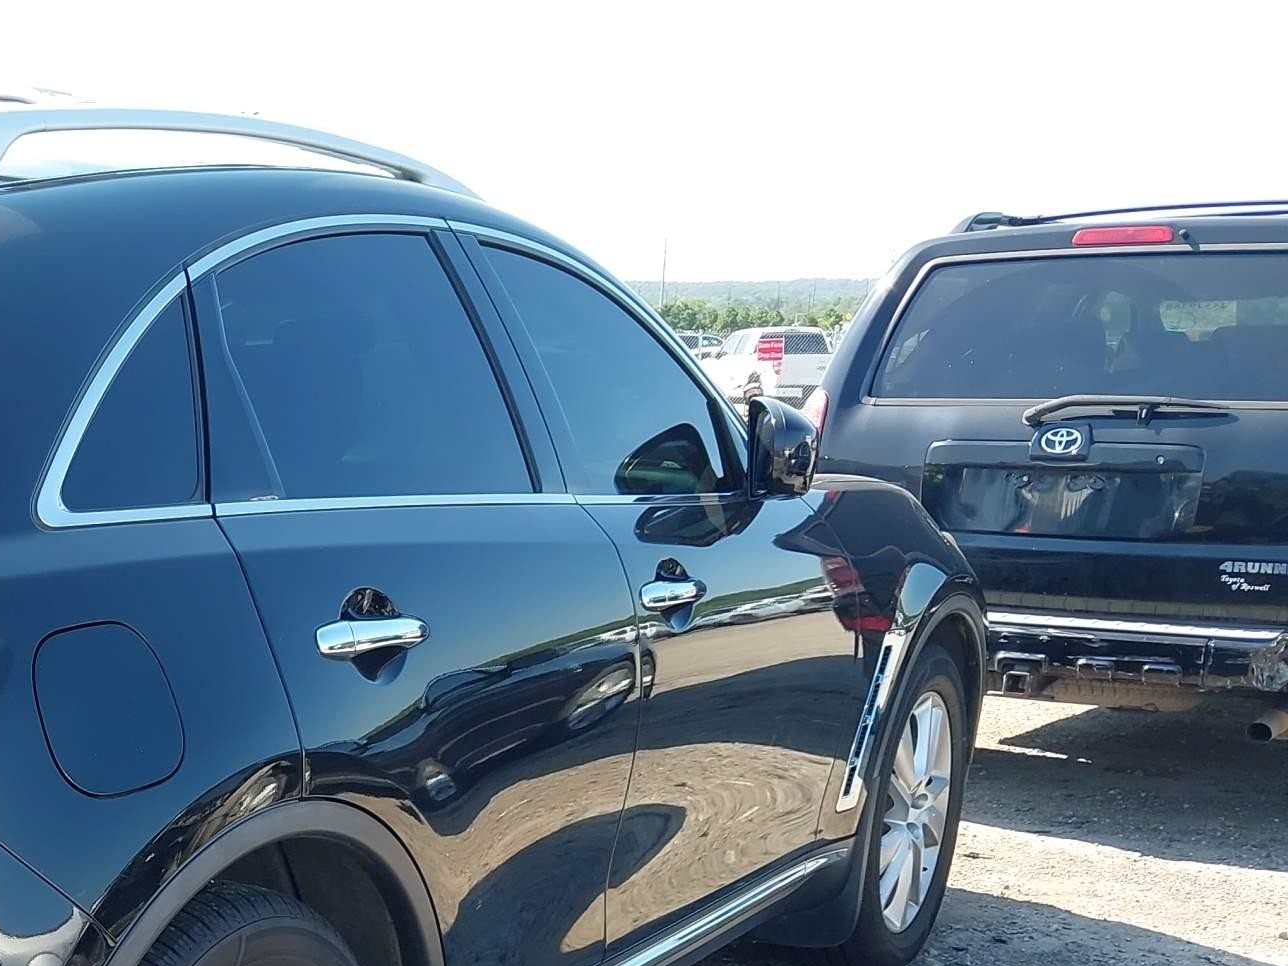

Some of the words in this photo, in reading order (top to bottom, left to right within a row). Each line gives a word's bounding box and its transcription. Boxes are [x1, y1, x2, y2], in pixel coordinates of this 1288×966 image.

[1219, 561, 1288, 575] 4RUNN
[1220, 574, 1245, 585] Toyota
[1240, 582, 1271, 592] Roswell
